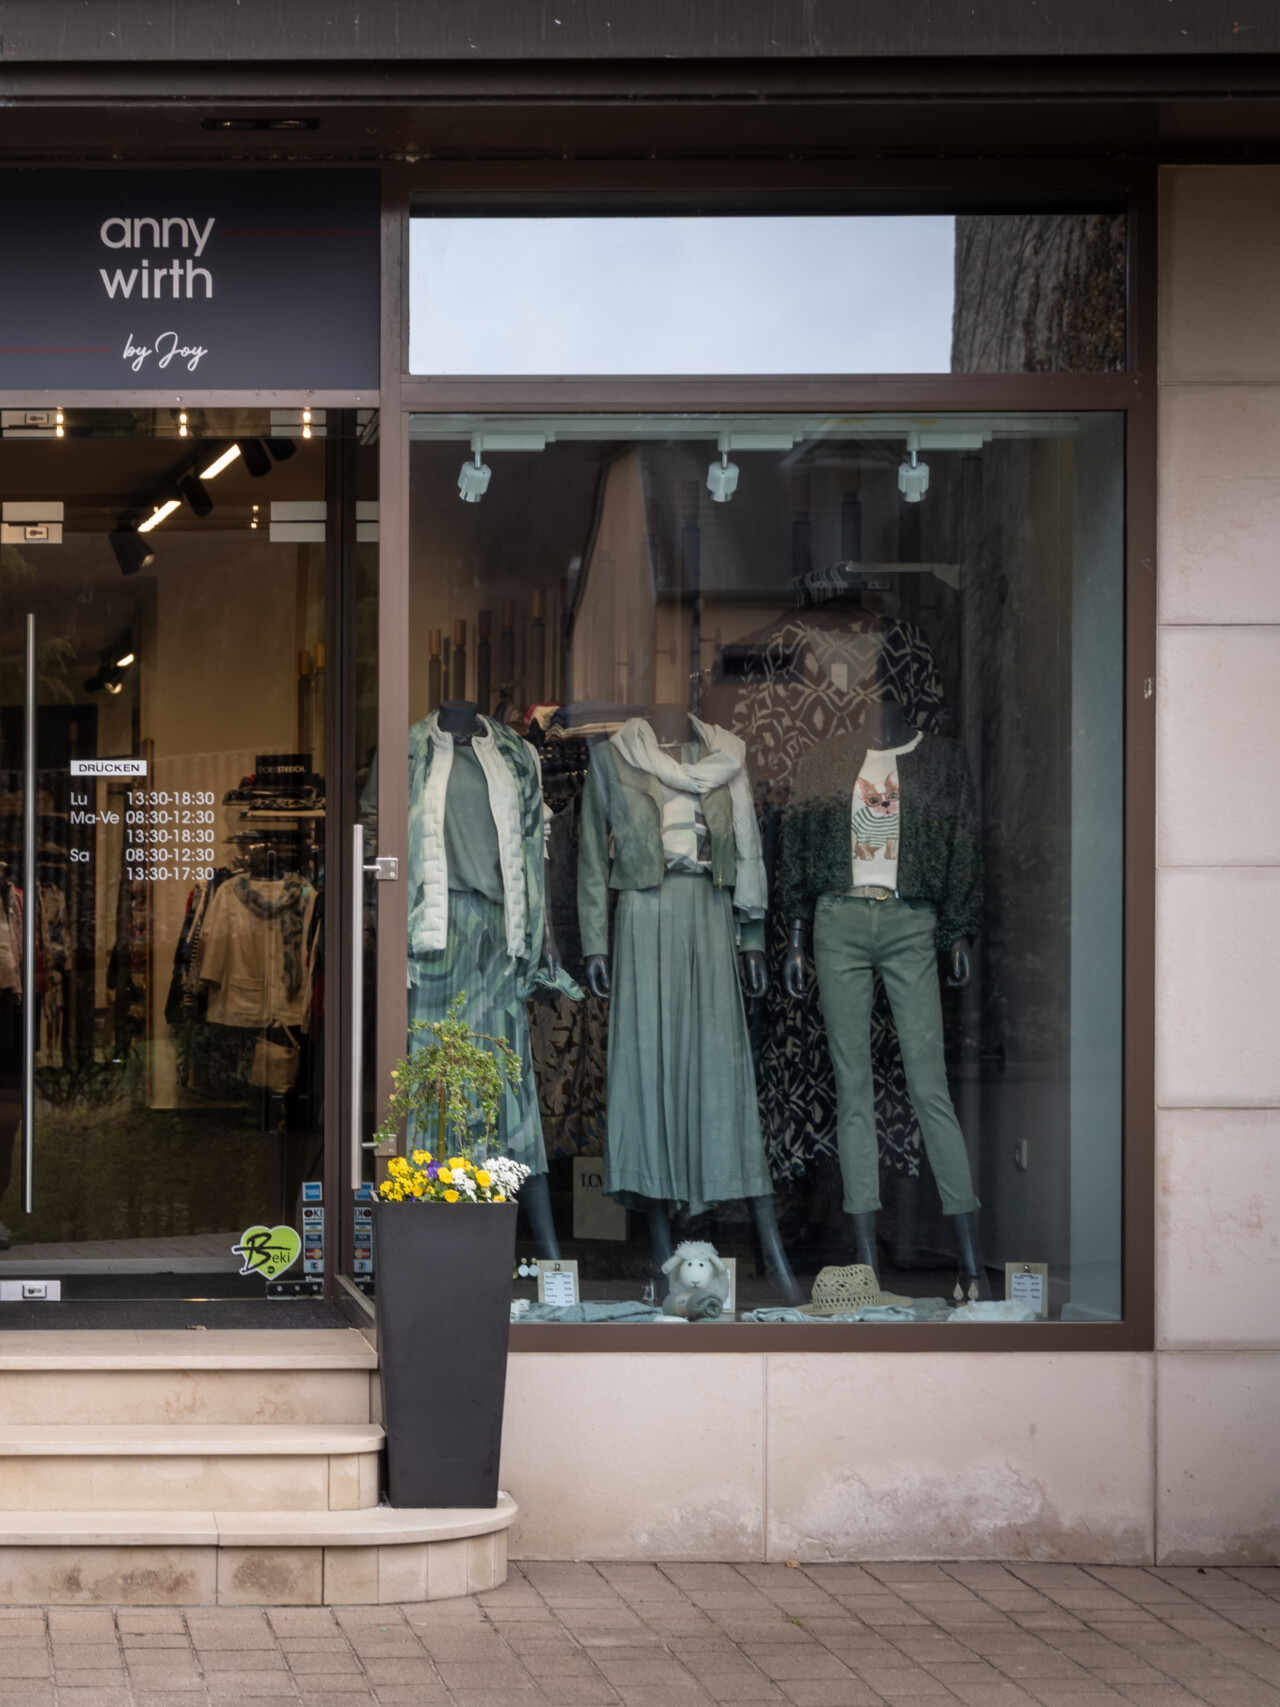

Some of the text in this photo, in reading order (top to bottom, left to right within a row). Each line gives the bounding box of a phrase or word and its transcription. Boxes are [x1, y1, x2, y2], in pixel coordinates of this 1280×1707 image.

[100, 217, 216, 257] anny
[100, 259, 214, 300] wirth
[122, 331, 208, 372] by Joy
[78, 761, 141, 773] DRÜCKEN
[70, 791, 215, 806] Lu 13:30-18:30
[70, 810, 215, 825] Ma-Ve 08:30-12:30
[127, 828, 215, 844] 13:30-18:30
[69, 847, 215, 863] Sa 08:30-12:30
[127, 866, 215, 882] 13:30-17:30
[234, 1232, 291, 1273] Beki
